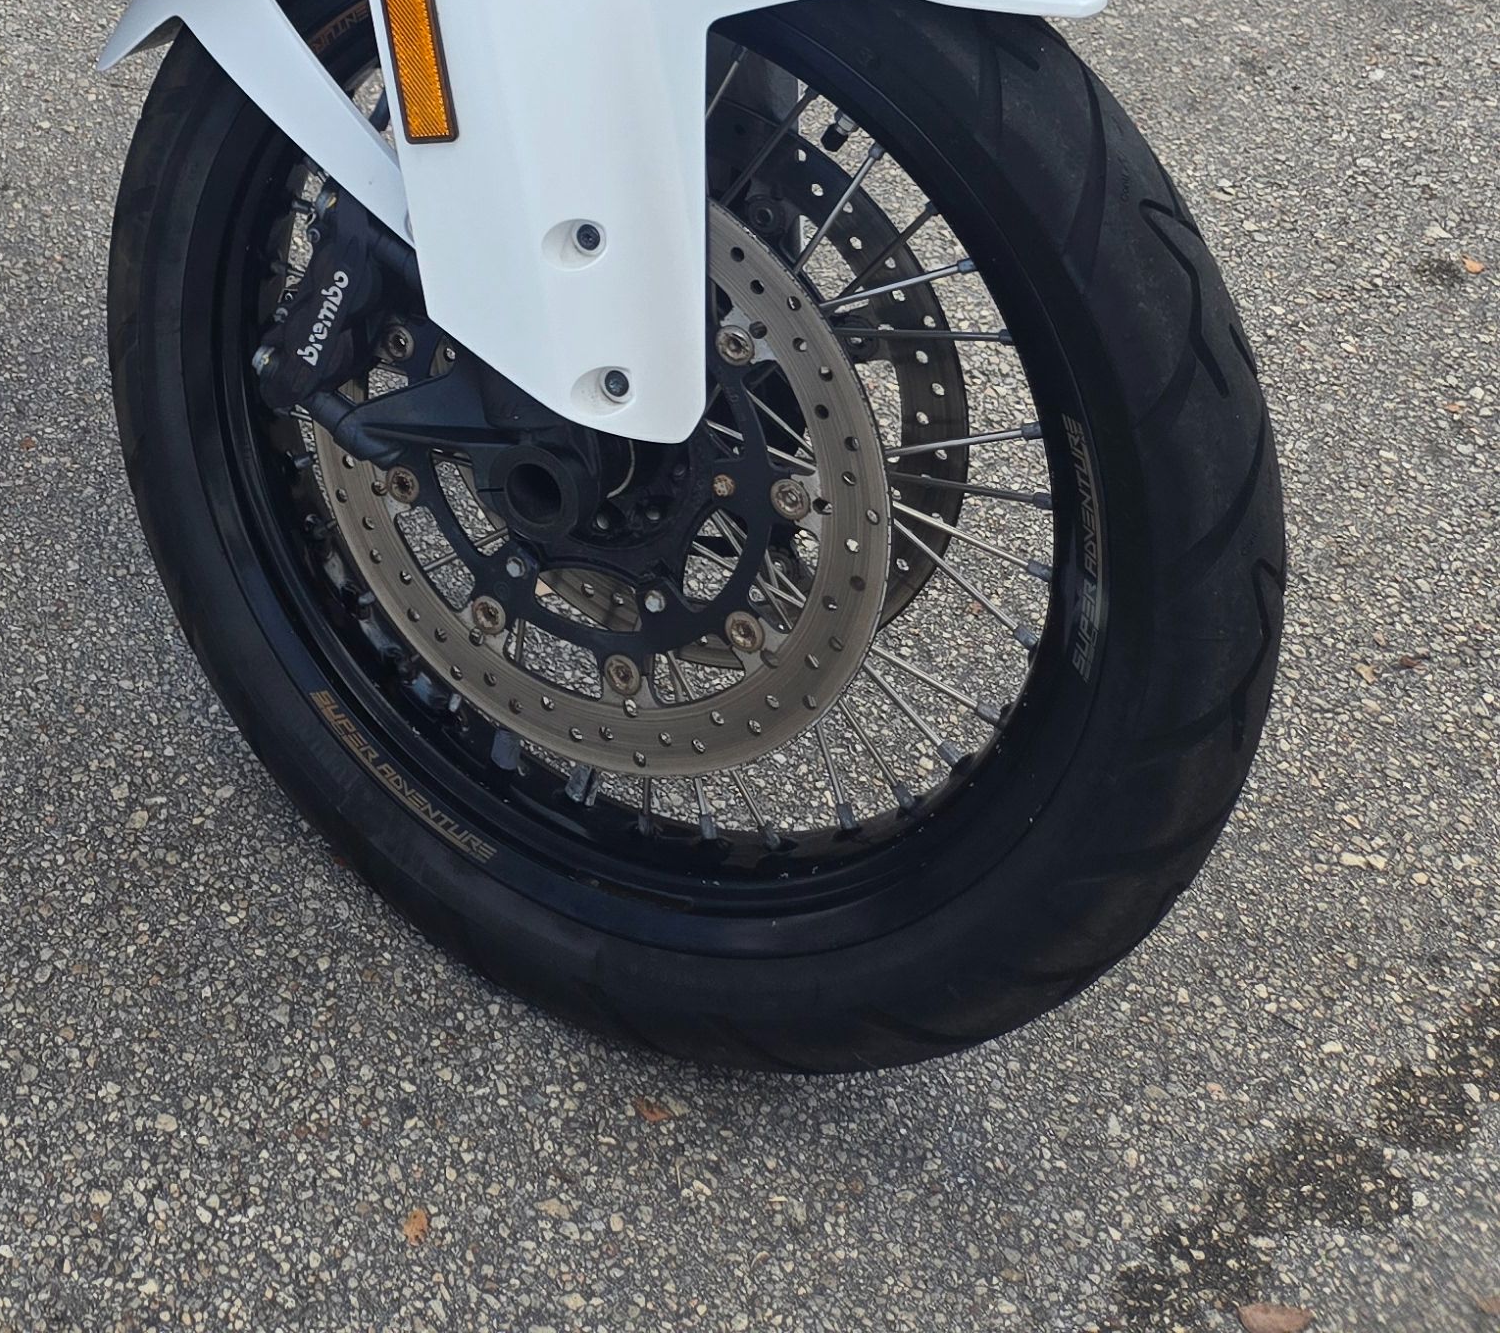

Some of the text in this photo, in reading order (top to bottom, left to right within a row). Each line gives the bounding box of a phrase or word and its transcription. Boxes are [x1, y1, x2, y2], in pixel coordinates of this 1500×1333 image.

[297, 270, 349, 367] brembo
[1062, 413, 1098, 677] SUPER ADVENTURE
[309, 690, 497, 861] SUPER ADVENTURE
